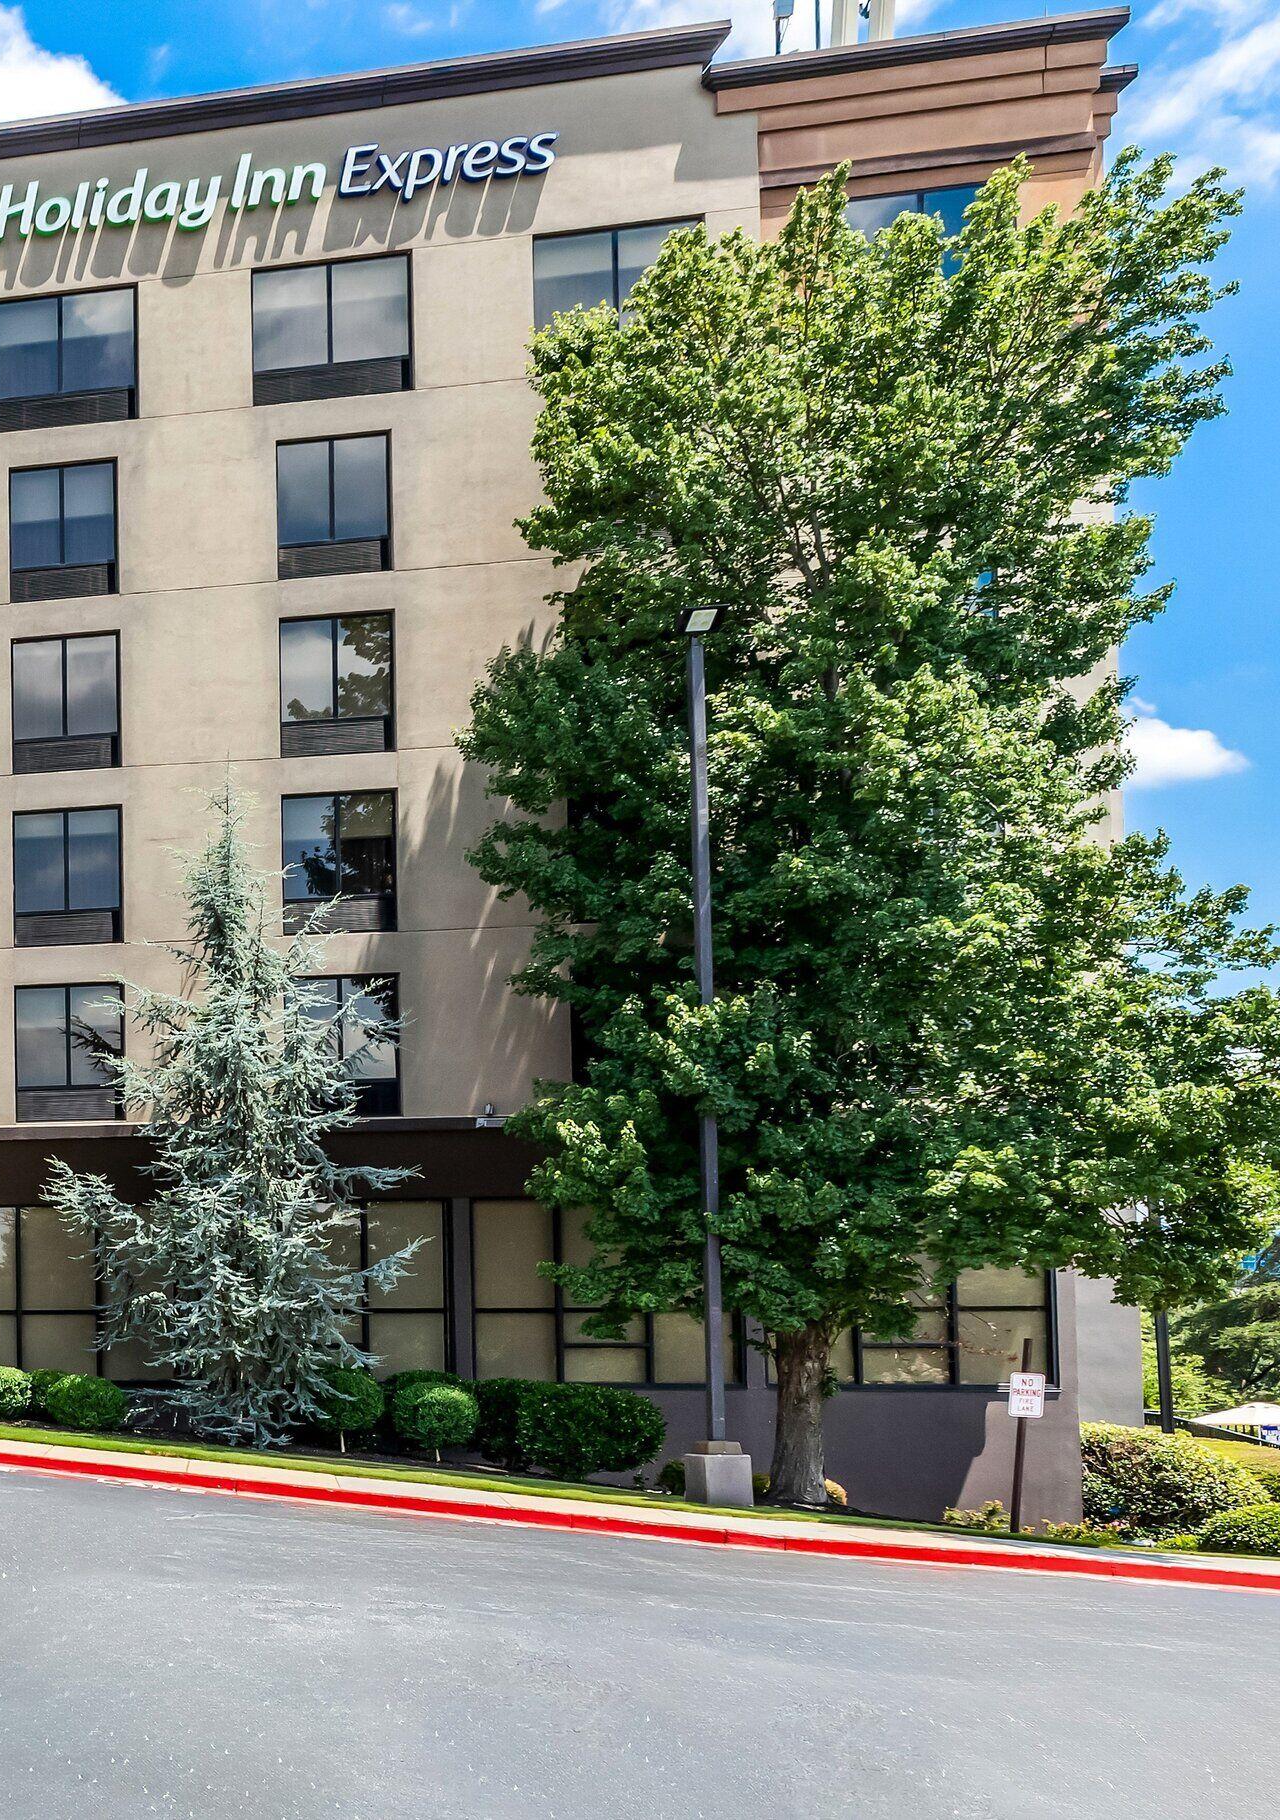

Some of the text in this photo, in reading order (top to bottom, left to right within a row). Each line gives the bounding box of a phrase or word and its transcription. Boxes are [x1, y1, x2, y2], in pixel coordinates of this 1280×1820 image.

[230, 152, 327, 211] Inn
[339, 131, 559, 203] Express
[1013, 1388, 1042, 1397] PARKING
